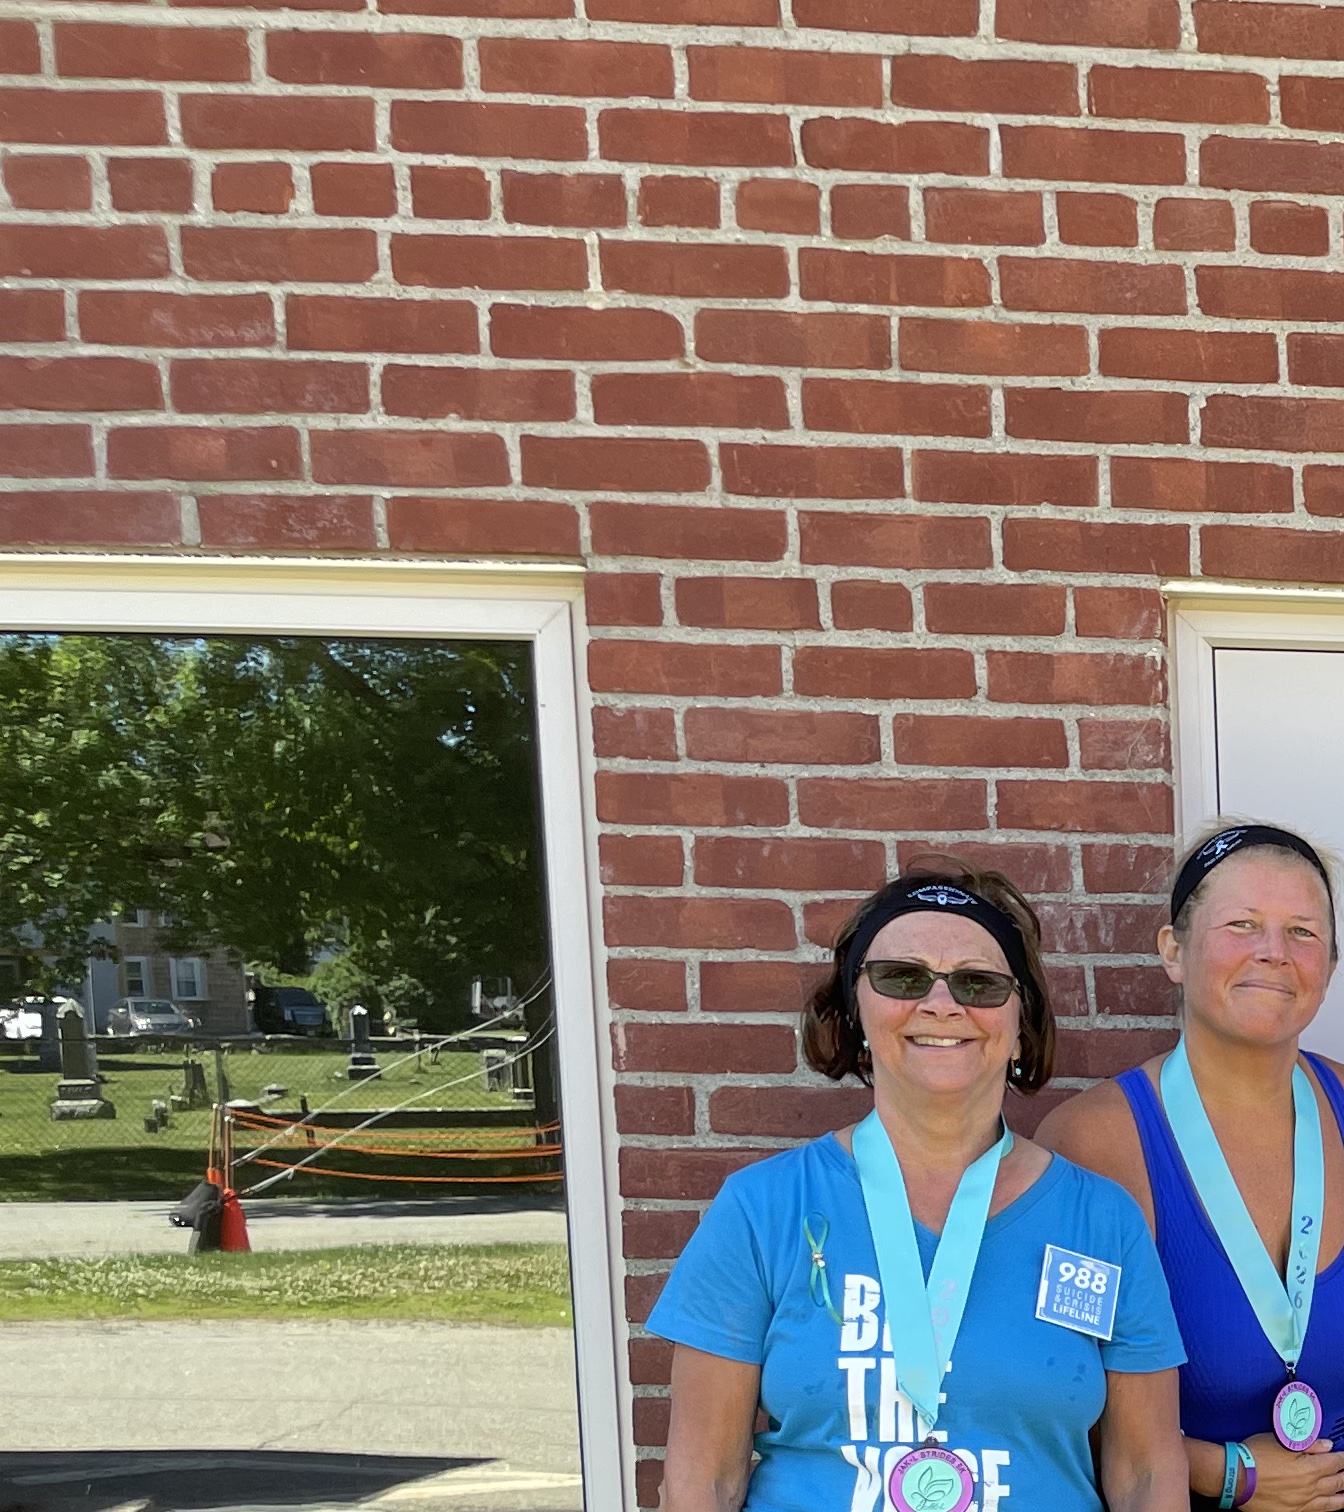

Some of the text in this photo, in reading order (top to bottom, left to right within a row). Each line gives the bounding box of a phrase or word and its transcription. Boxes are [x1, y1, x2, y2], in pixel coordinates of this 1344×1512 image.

[1058, 1262, 1108, 1294] 988
[1055, 1284, 1104, 1306] SUICIDE
[1064, 1296, 1102, 1315] CRISIS
[1053, 1302, 1100, 1325] LIFELINE
